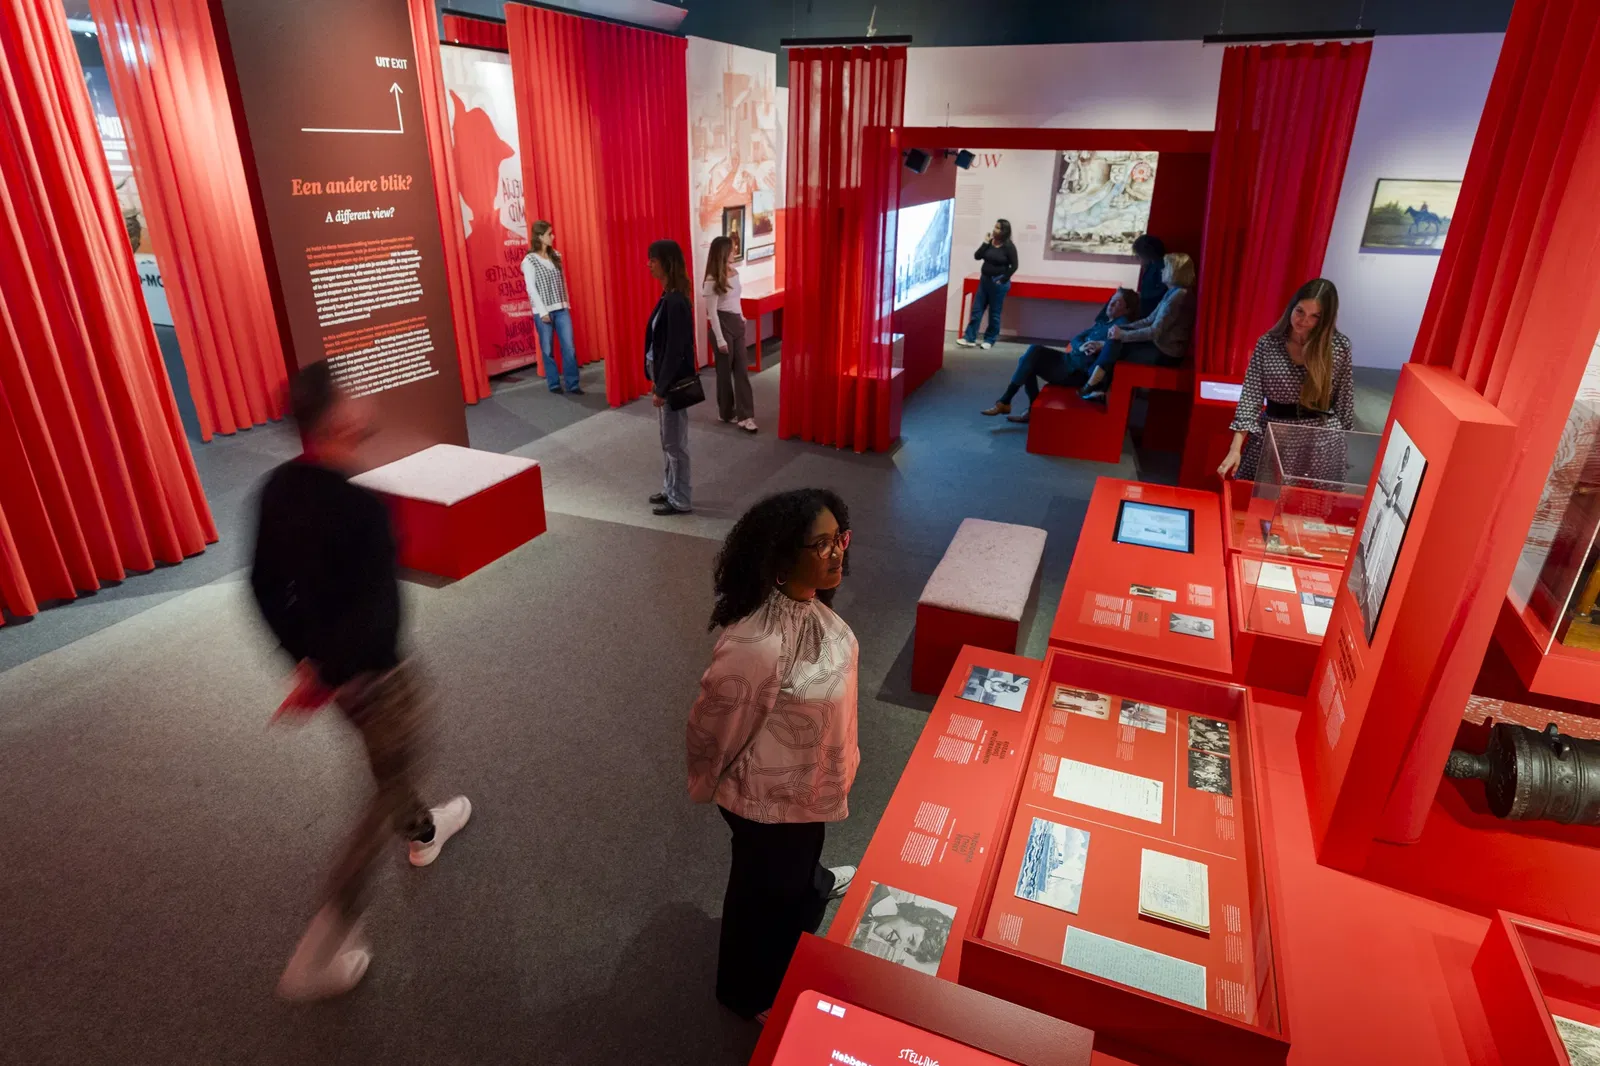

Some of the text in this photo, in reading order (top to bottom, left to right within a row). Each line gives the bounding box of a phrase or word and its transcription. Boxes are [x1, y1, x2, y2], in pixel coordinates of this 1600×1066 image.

[375, 56, 407, 70] UIT EXIT
[291, 175, 412, 196] Een andere blik?
[325, 207, 395, 224] A different view?
